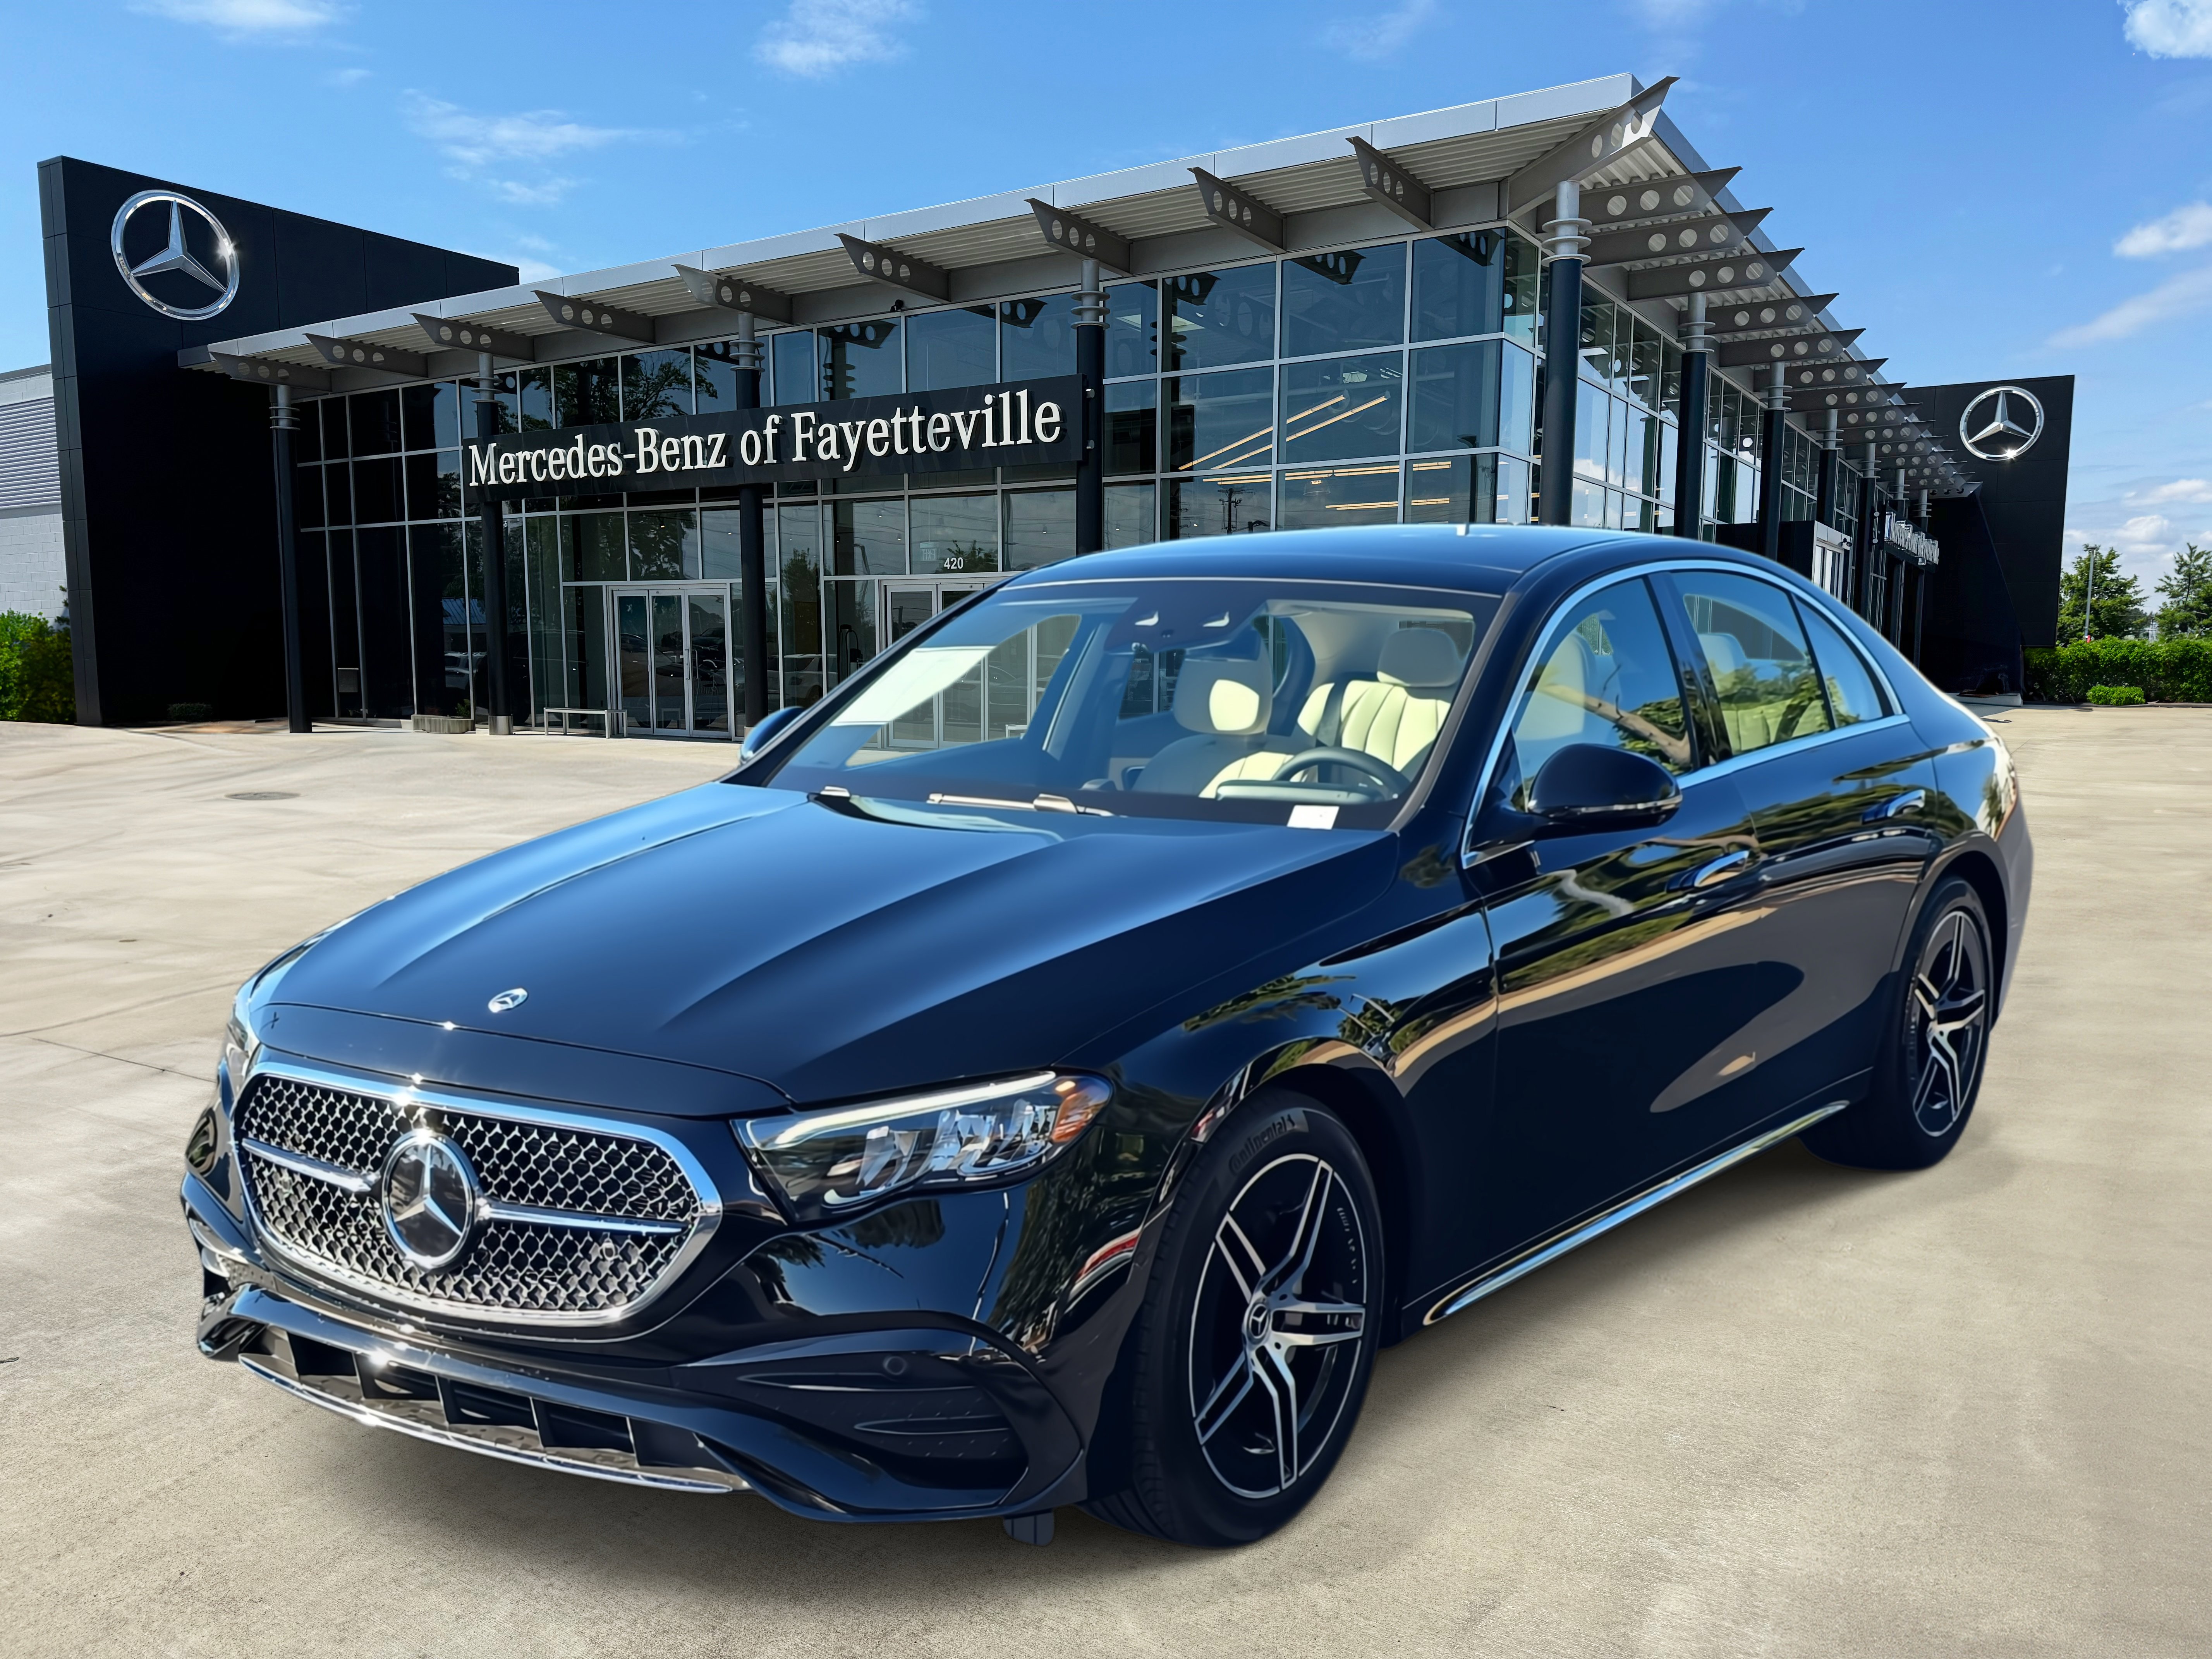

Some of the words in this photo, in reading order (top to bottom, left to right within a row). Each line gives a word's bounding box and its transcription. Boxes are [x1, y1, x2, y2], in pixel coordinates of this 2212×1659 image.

[469, 428, 726, 487] Mercedes-Benz
[740, 414, 783, 466] of
[791, 389, 1061, 472] Fayetteville
[944, 557, 963, 569] 420
